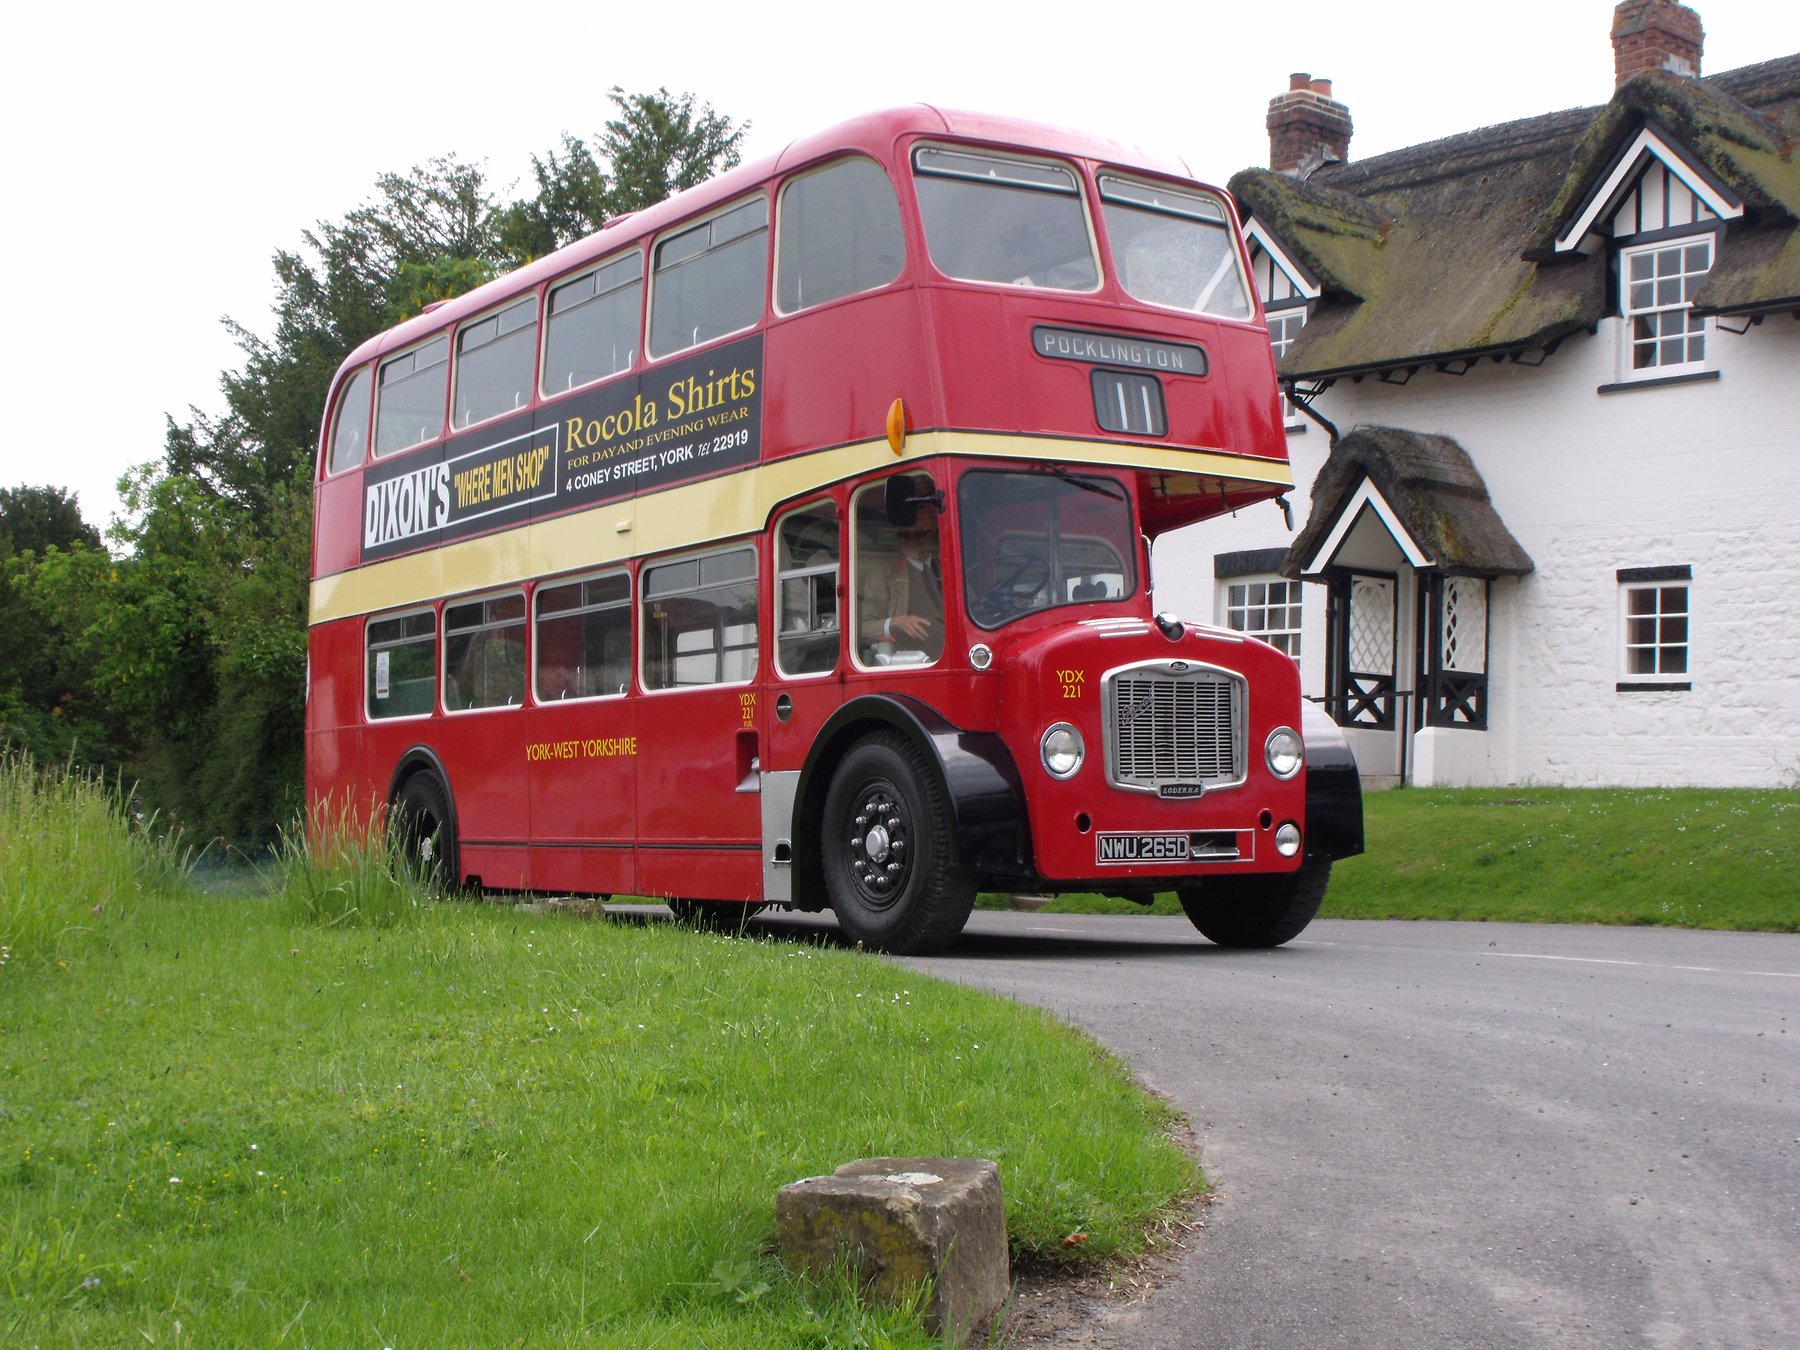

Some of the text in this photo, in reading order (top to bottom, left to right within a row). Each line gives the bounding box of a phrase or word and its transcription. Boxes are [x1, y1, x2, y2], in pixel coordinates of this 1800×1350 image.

[1044, 334, 1183, 369] POCKLINGTON
[564, 367, 755, 453] Rocola Shirts
[567, 407, 749, 470] FOR DAY AND EVENING WEAR
[565, 478, 572, 492] 4
[574, 468, 611, 490] CONEY
[613, 455, 658, 480] STREET,
[659, 444, 694, 467] YORK
[713, 429, 748, 453] 22919
[365, 463, 450, 549] DIXON'S
[492, 456, 514, 498] MEN
[1056, 670, 1085, 683] YDX
[739, 693, 757, 706] YDX
[1062, 685, 1081, 698] 221
[742, 706, 754, 719] 221
[525, 737, 637, 761] YORK-WEST YORKSHIRE
